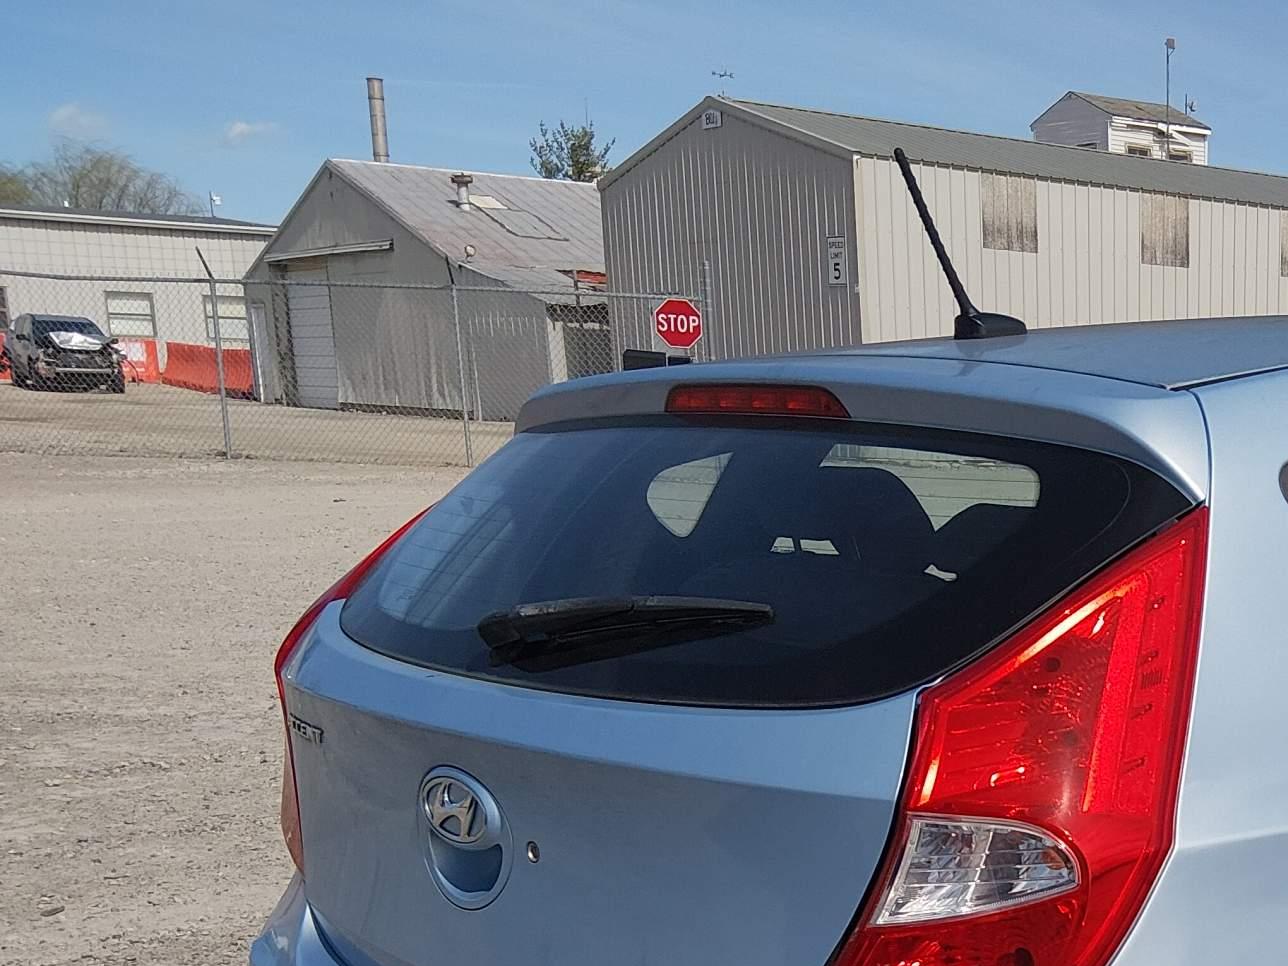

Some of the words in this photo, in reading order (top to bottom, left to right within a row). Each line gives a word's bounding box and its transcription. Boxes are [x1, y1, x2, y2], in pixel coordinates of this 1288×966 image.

[828, 241, 844, 249] SPEED
[830, 251, 843, 260] LIMIT
[833, 262, 841, 280] 5
[658, 313, 699, 333] STOP
